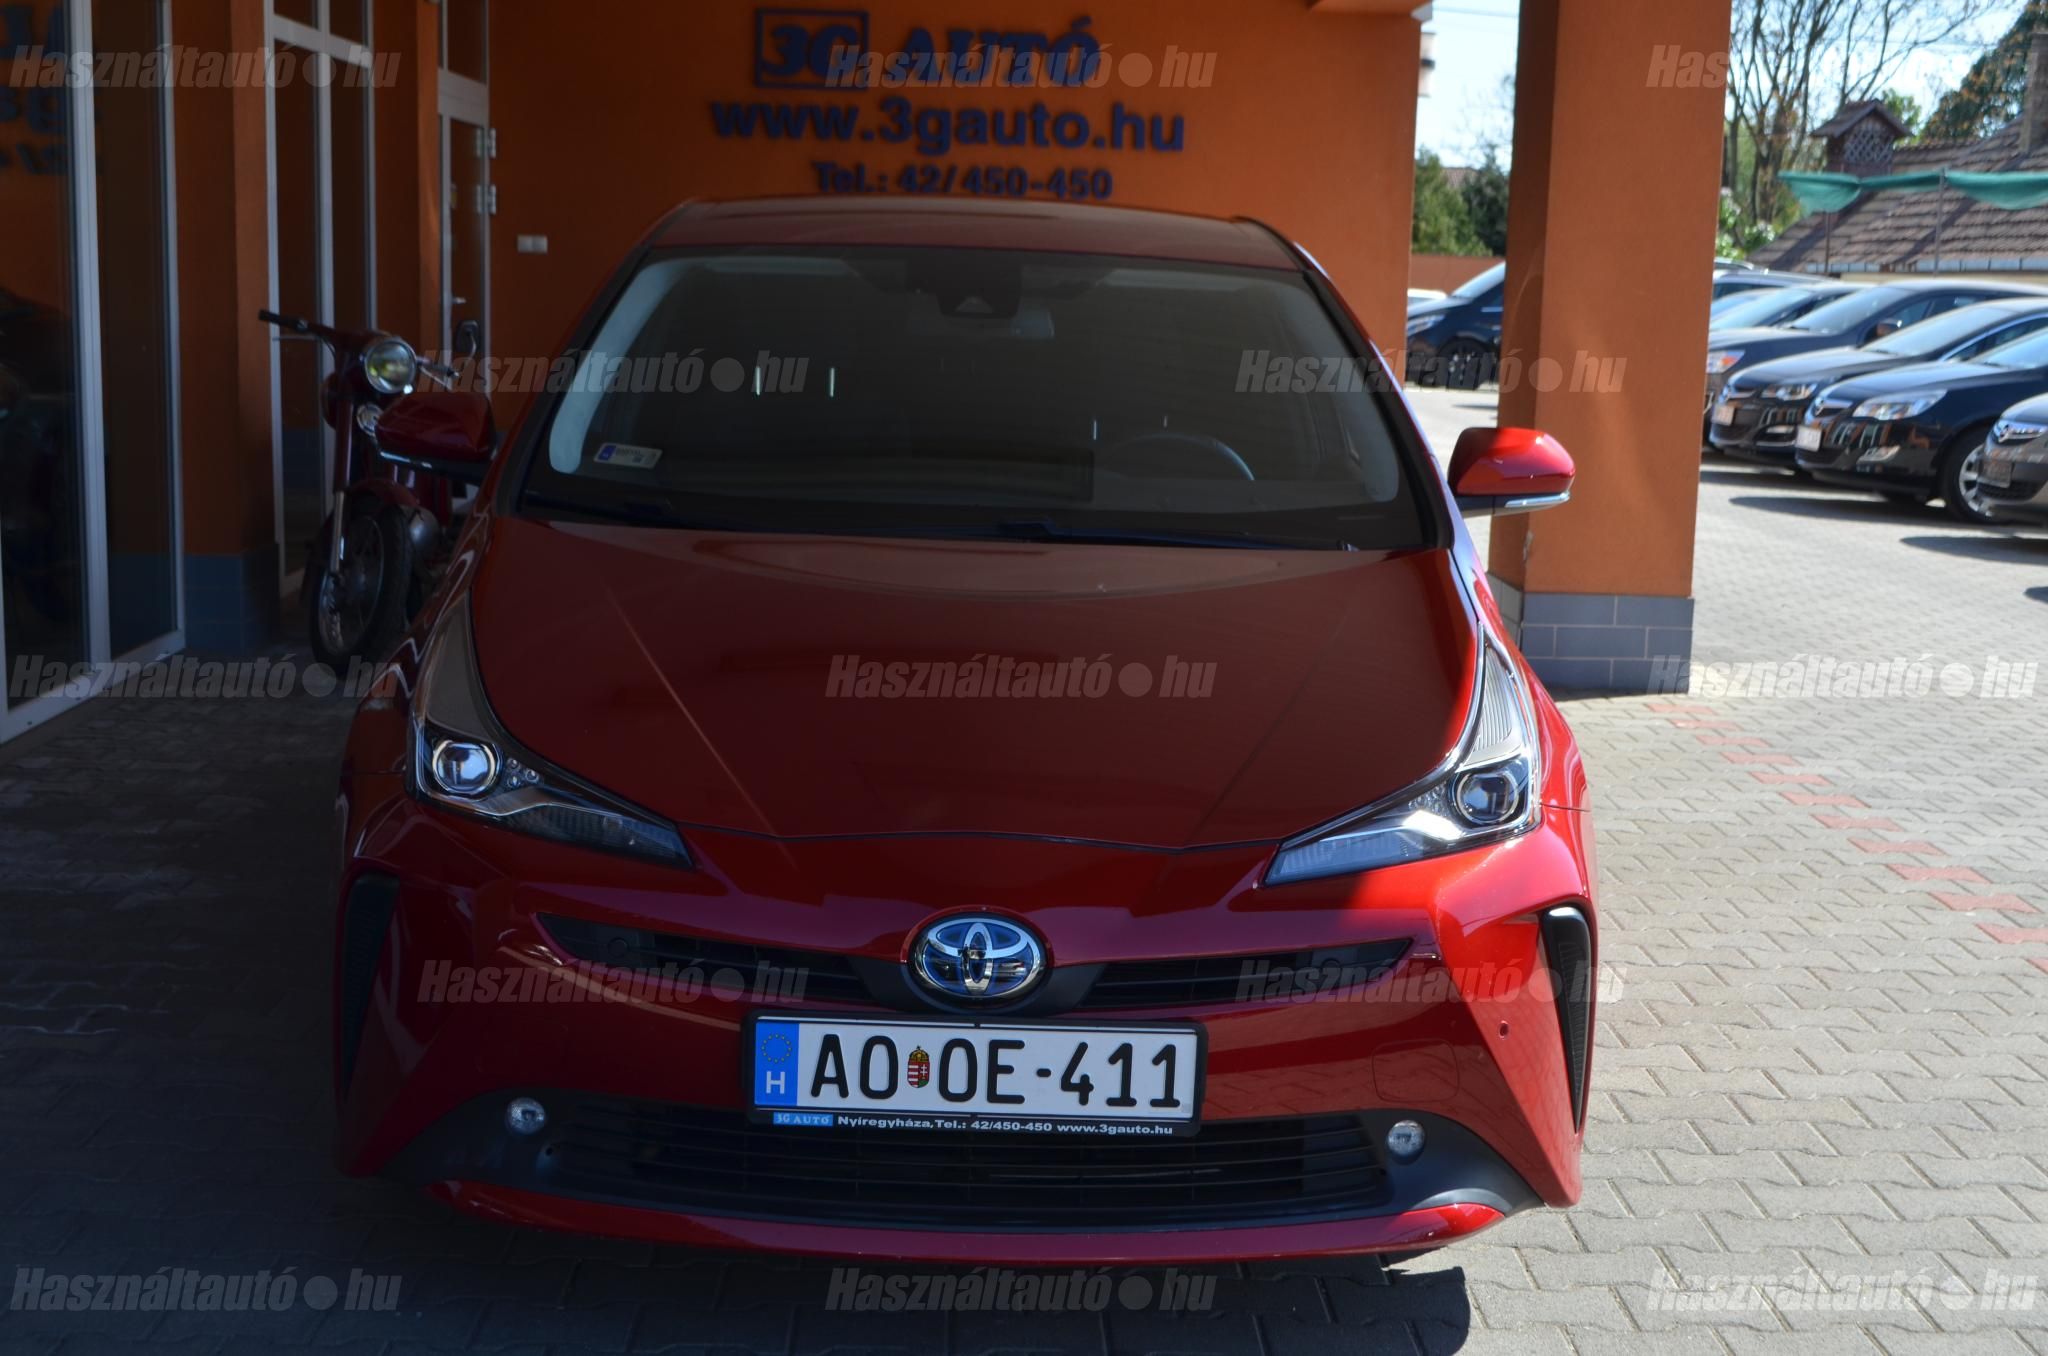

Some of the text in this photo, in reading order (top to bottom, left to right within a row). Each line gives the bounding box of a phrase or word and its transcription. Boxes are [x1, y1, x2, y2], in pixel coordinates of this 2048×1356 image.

[710, 96, 1186, 156] www.3gauto.hu
[812, 161, 889, 193] Tel.:
[765, 1071, 786, 1095] H
[971, 1121, 1052, 1131] 42/450-450
[1057, 1124, 1173, 1135] www.3gauto.hu
